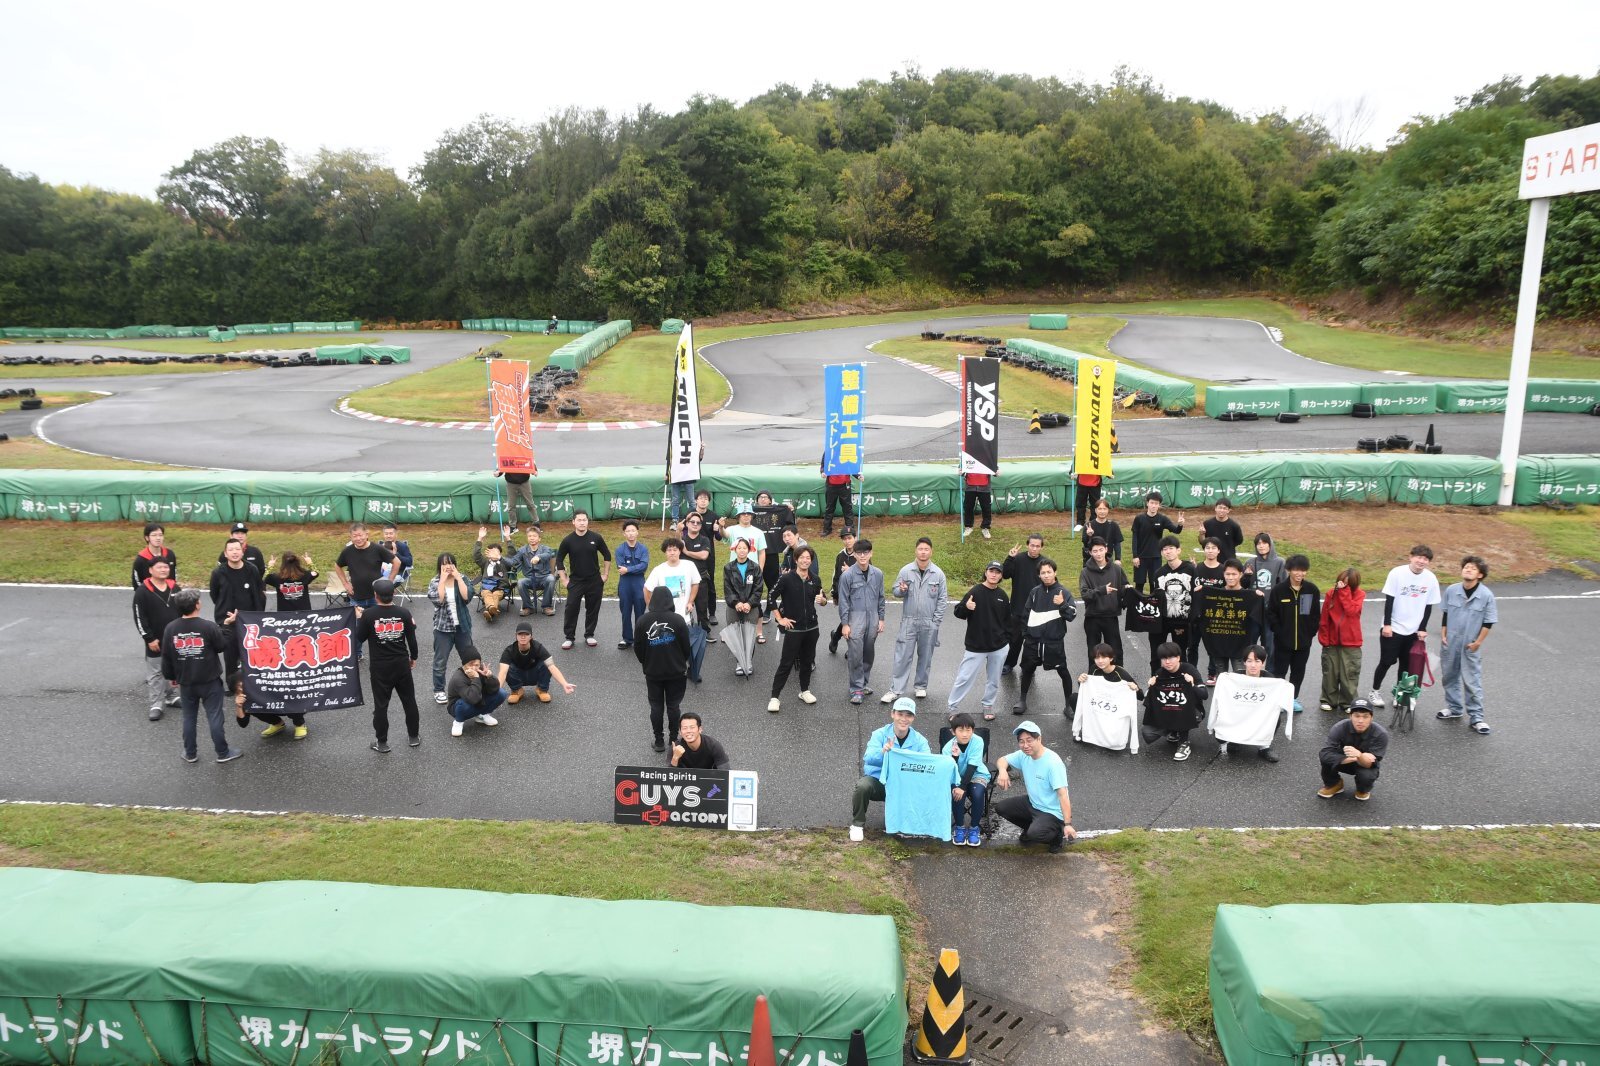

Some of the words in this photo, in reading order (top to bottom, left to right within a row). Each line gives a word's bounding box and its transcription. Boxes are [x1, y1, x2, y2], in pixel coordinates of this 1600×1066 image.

[1227, 401, 1281, 410] 堺カートランド
[1300, 399, 1352, 408] 堺カートランド
[1374, 396, 1428, 406] 堺カートランド
[1457, 397, 1508, 407] 堺カートラン
[1531, 394, 1595, 404] 堺カートランド
[839, 369, 860, 464] 整備工具
[974, 382, 996, 441] YSP
[676, 377, 692, 464] TAICHI
[1090, 382, 1101, 470] DUNLOP
[827, 413, 839, 472] ストレート
[1190, 482, 1268, 497] 堺カートランド
[1299, 477, 1378, 492] 堺カートランド
[1407, 478, 1487, 493] 堺カートランド
[1539, 483, 1600, 495] 堺カートラ
[21, 499, 102, 514] 堺カートランド
[135, 500, 215, 514] 堺カートランド
[249, 503, 331, 517] 堺カートランド
[368, 498, 453, 513] 堺カートランド
[488, 499, 574, 513] 堺カーランド
[610, 497, 691, 511] 堺カートラ
[261, 617, 308, 627] Racing
[307, 613, 342, 624] Team
[275, 626, 331, 634] ギャンブラー
[1233, 691, 1266, 702] ふくろう
[266, 702, 285, 710] 2022
[1090, 698, 1118, 713] ふくろう
[640, 770, 667, 781] Racing
[668, 772, 697, 781] Spirits
[615, 779, 701, 808] GUYS
[239, 1014, 481, 1060] 堺カートランド
[588, 1030, 843, 1066] 堺カートンド
